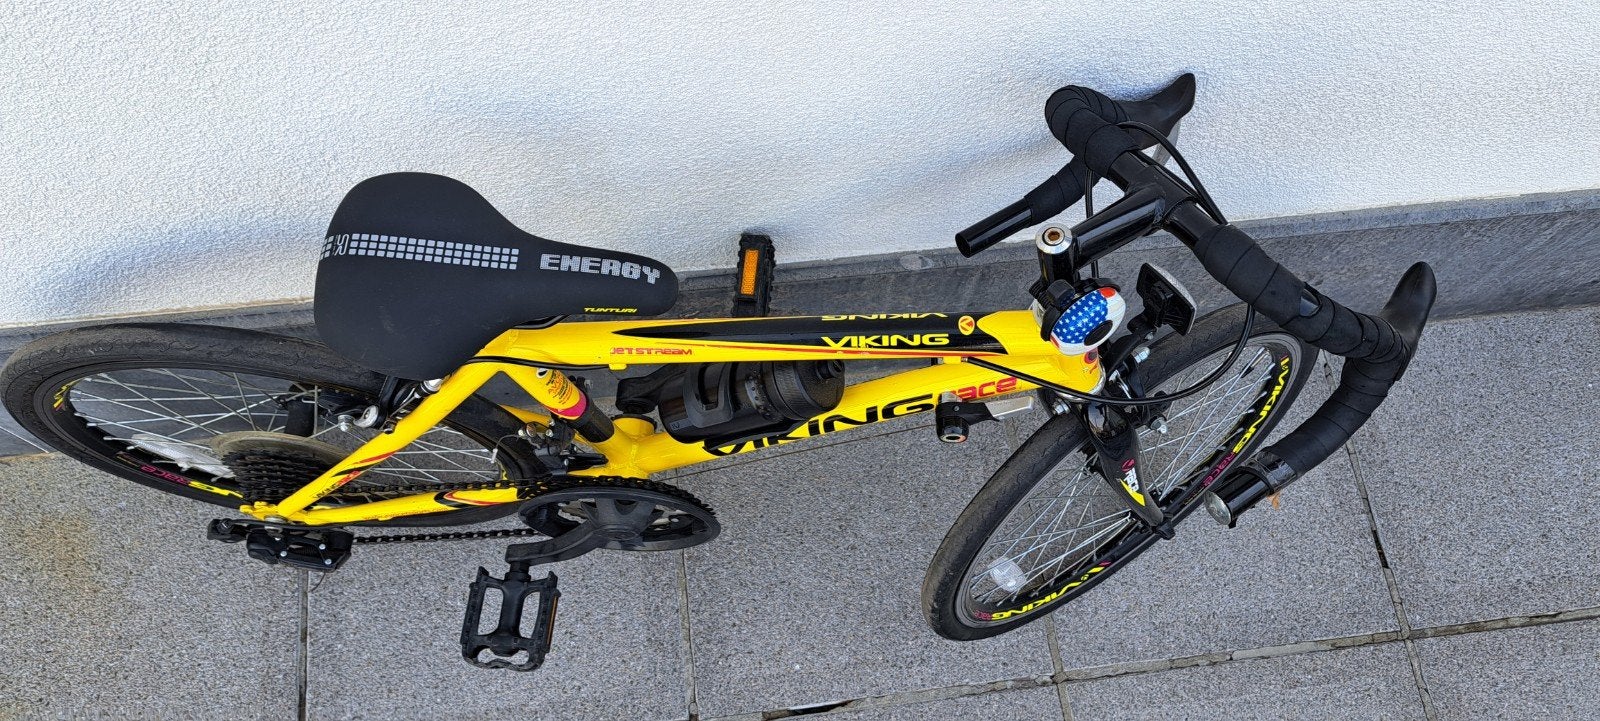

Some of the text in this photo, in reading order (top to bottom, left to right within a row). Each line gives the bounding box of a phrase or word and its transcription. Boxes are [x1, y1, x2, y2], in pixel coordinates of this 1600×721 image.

[540, 253, 661, 285] ENERGY
[821, 333, 950, 348] VIKING
[1232, 369, 1289, 454] VIKING
[991, 581, 1082, 620] VIKING
